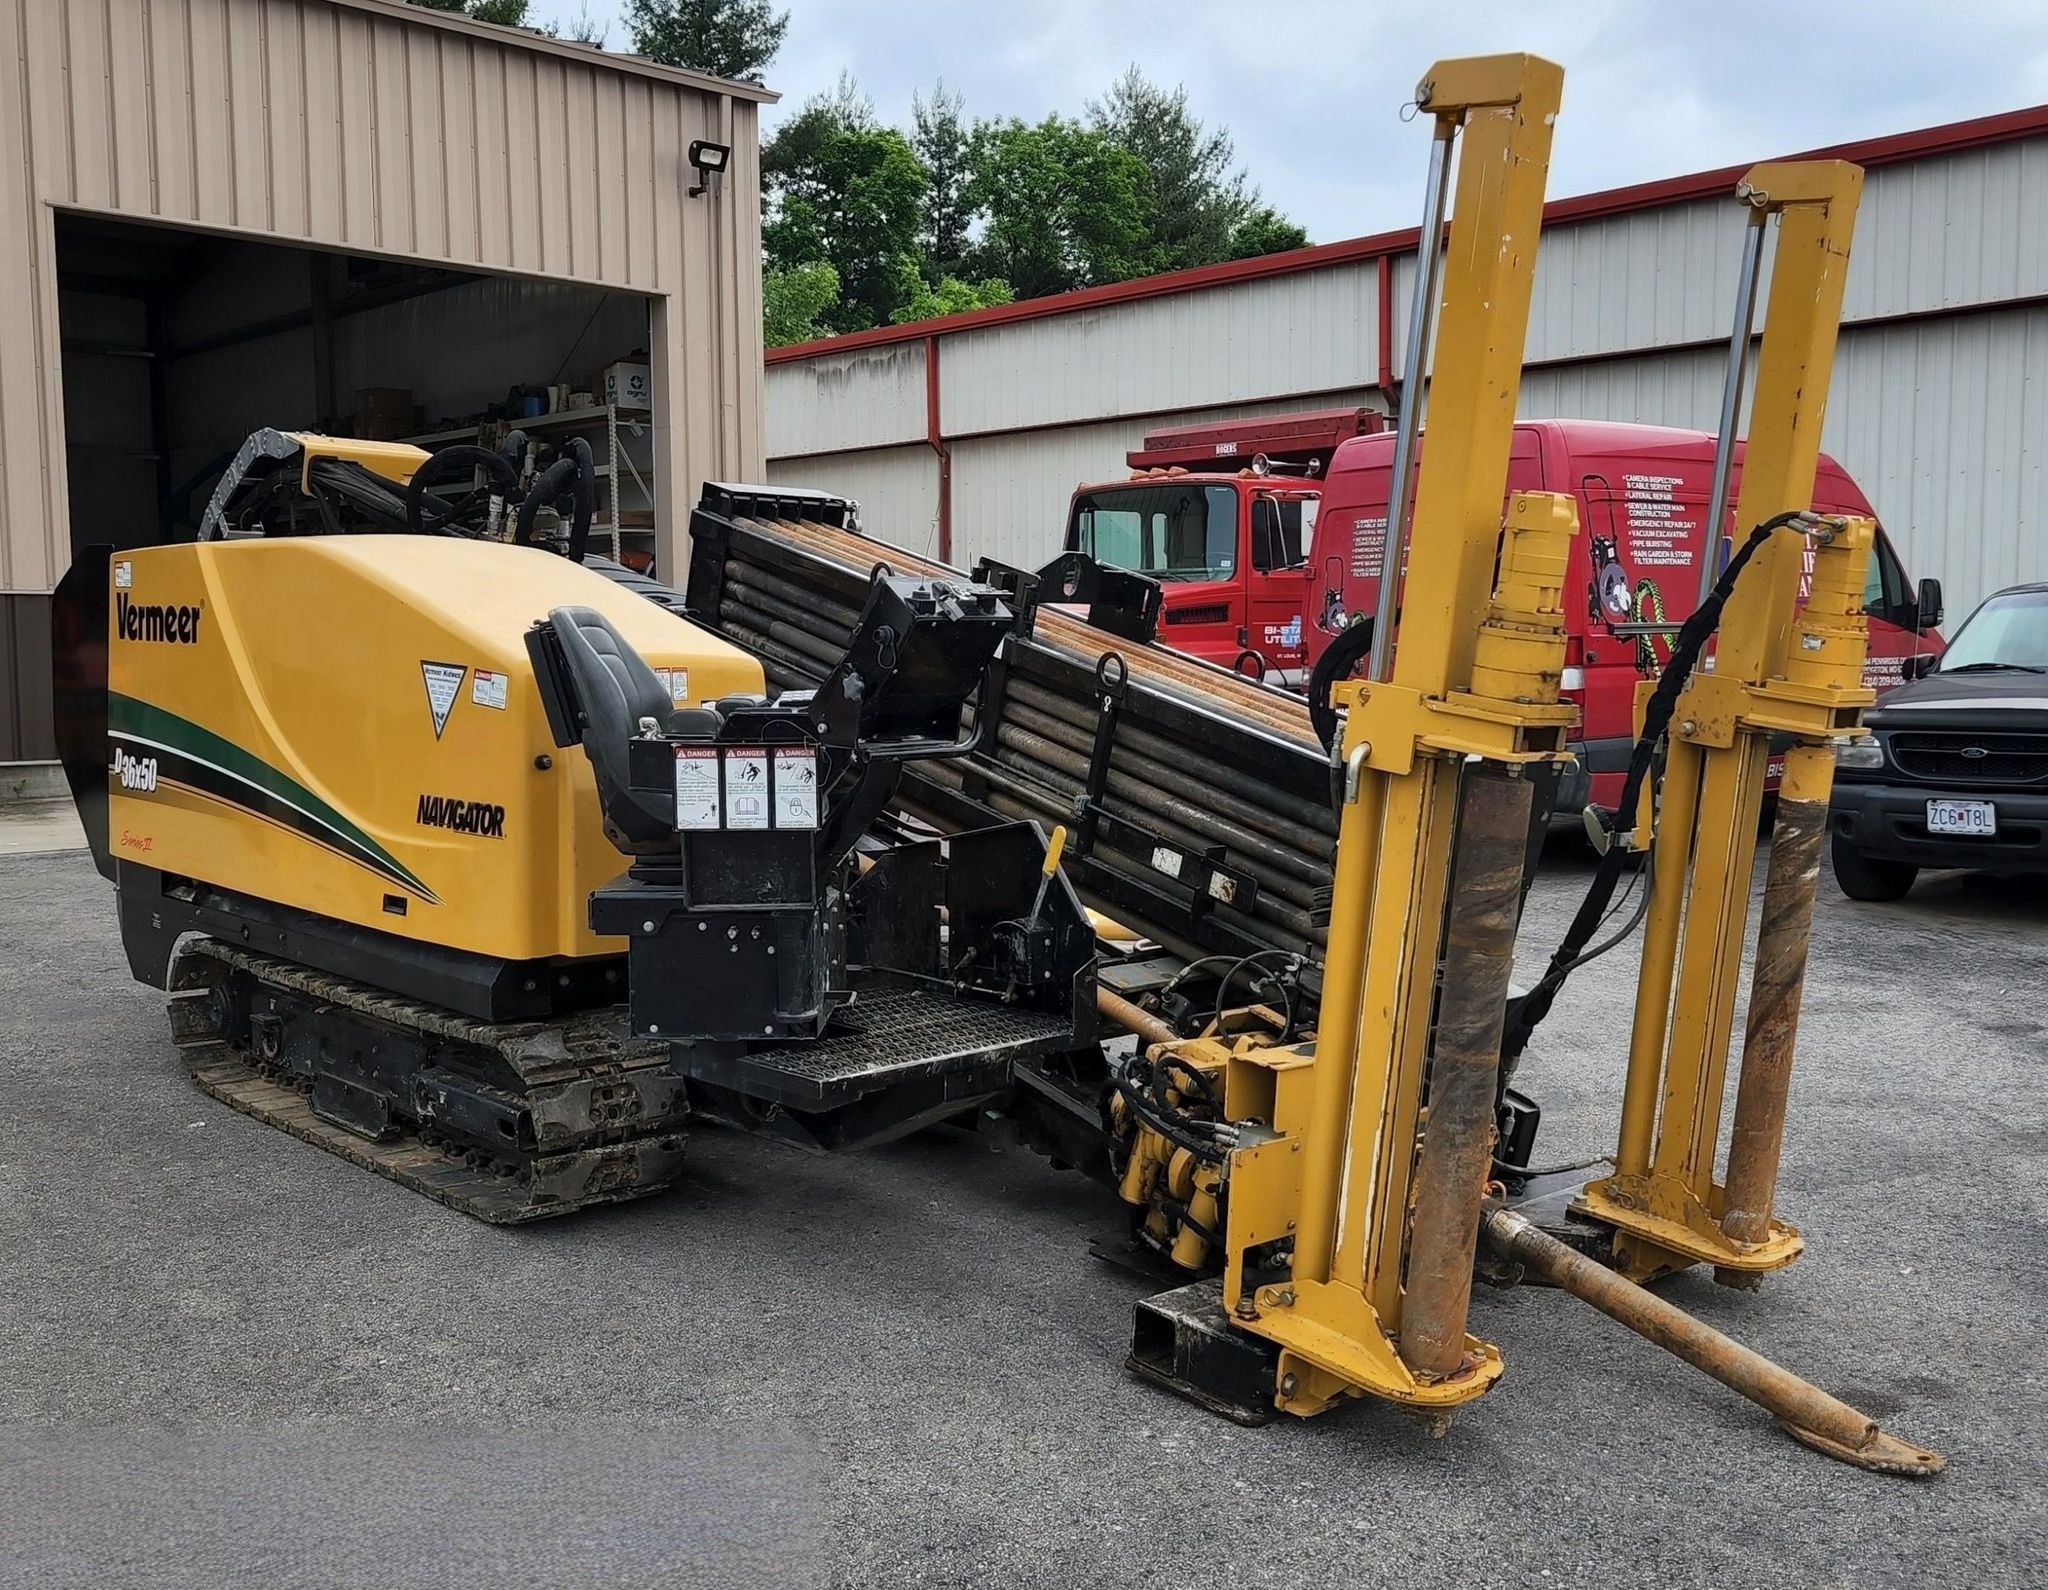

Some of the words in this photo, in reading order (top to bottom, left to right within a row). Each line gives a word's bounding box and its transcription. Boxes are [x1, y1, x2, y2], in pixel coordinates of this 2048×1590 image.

[1625, 474, 1648, 482] CAMERA
[1649, 476, 1684, 485] INSPECTIONS
[1632, 482, 1649, 490] CABLE
[1628, 491, 1652, 499] LATERAL
[1653, 493, 1672, 501] REPAIR
[1627, 502, 1648, 510] SEWER
[1652, 503, 1671, 511] WATER
[1628, 510, 1671, 518] CONSTRUCTION
[1630, 519, 1663, 527] EMERGENCY
[1664, 521, 1683, 529] REPAIR
[1683, 521, 1696, 529] 24/7
[1633, 549, 1647, 557] RAIN
[1648, 550, 1670, 558] GARDEN
[1635, 557, 1653, 565] FILTER
[116, 592, 200, 644] Vermeer
[114, 748, 157, 791] D36x50
[416, 794, 504, 837] NAVIGATOR
[1930, 807, 1957, 825] ZC6
[1963, 809, 1992, 827] T8L
[120, 830, 144, 849] Series
